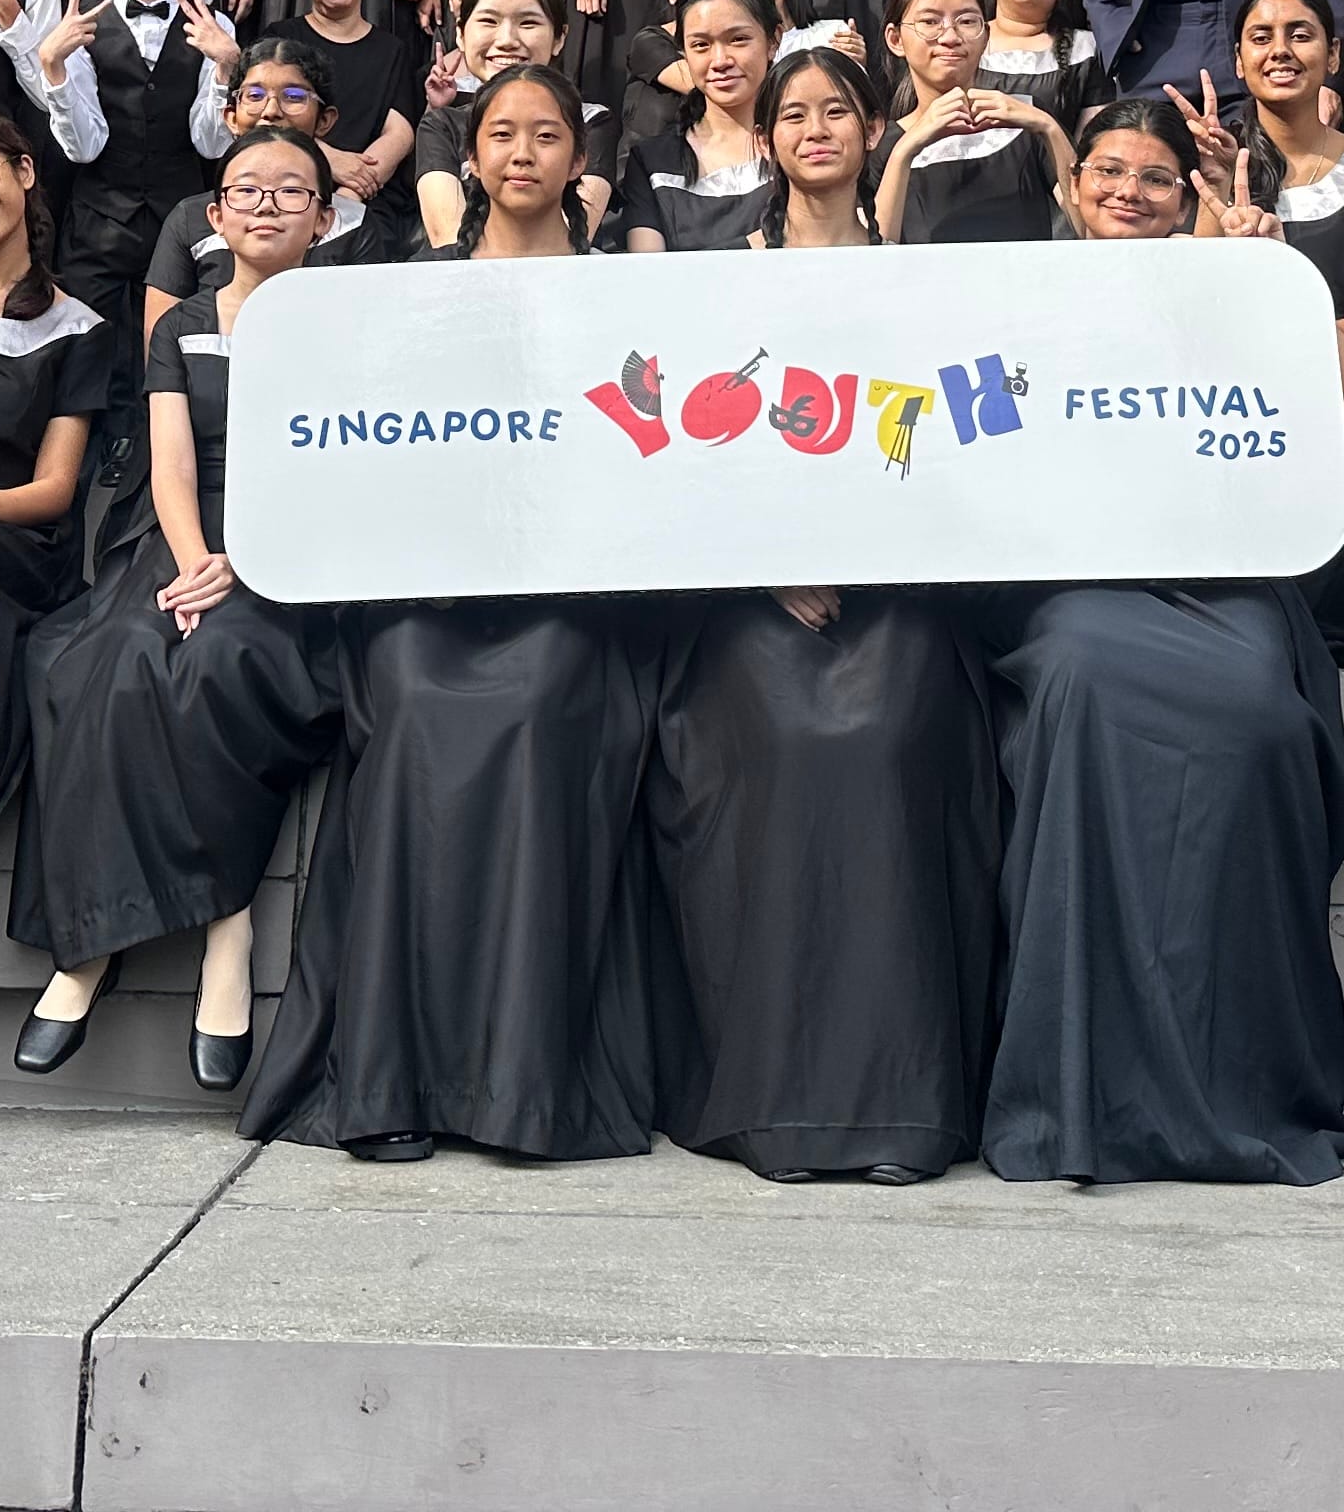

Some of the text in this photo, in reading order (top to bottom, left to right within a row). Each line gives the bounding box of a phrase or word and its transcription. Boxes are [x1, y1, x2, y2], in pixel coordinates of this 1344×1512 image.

[289, 348, 1280, 476] SINGAPORE YOUTH FESTIVAL
[1195, 429, 1287, 460] 2025
